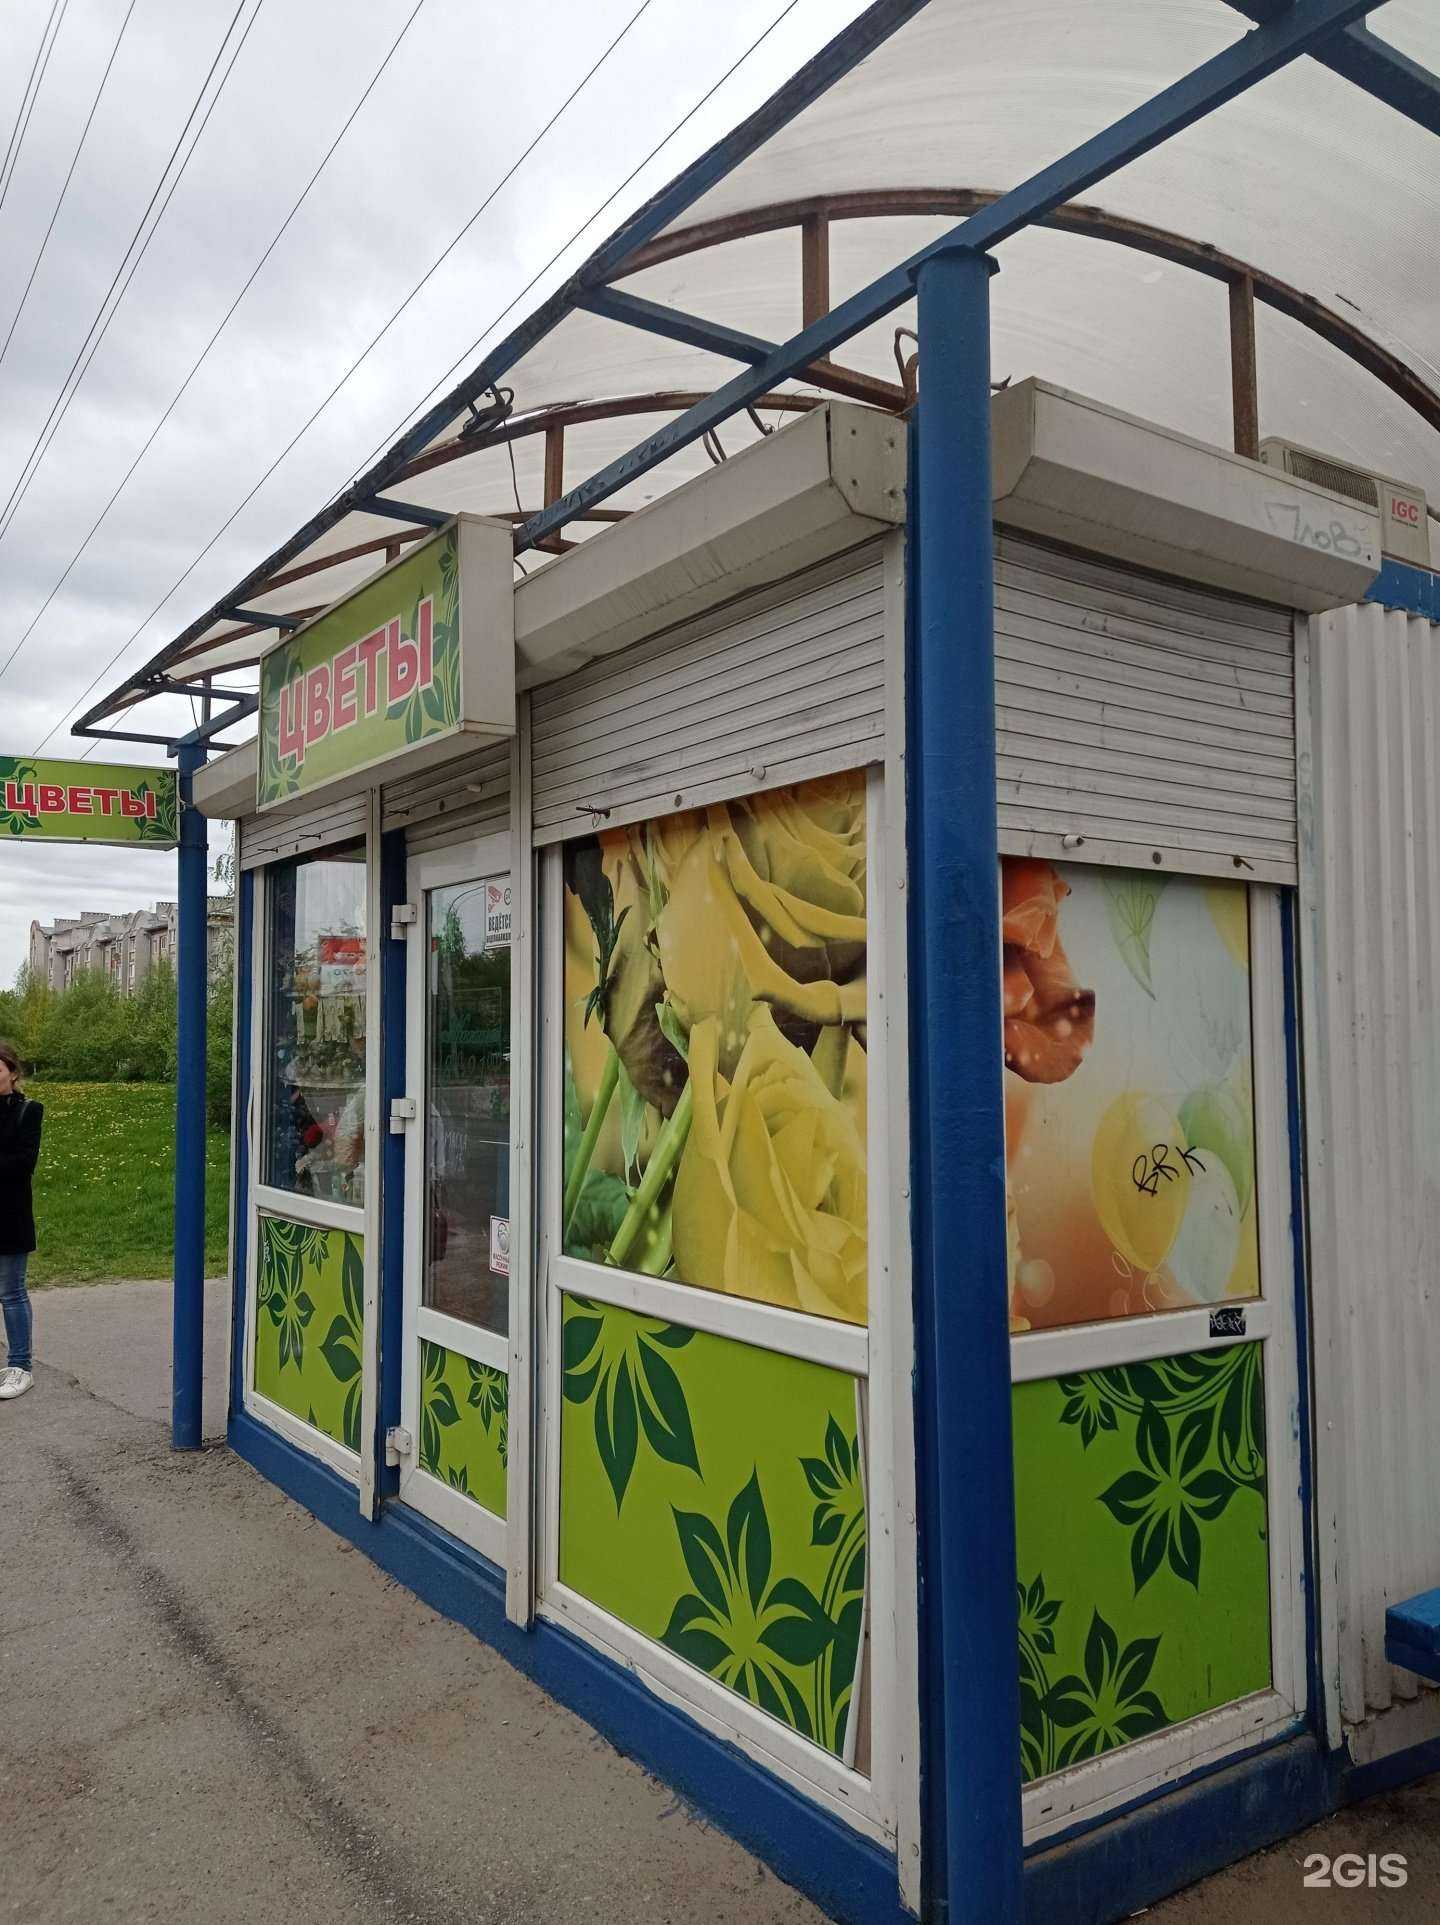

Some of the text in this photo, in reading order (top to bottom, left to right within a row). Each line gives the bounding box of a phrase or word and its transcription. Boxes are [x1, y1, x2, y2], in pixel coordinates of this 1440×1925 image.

[1391, 498, 1419, 522] IGC
[278, 594, 434, 768] ЦВЕТЫ
[5, 782, 157, 818] ЦВЕТЫ
